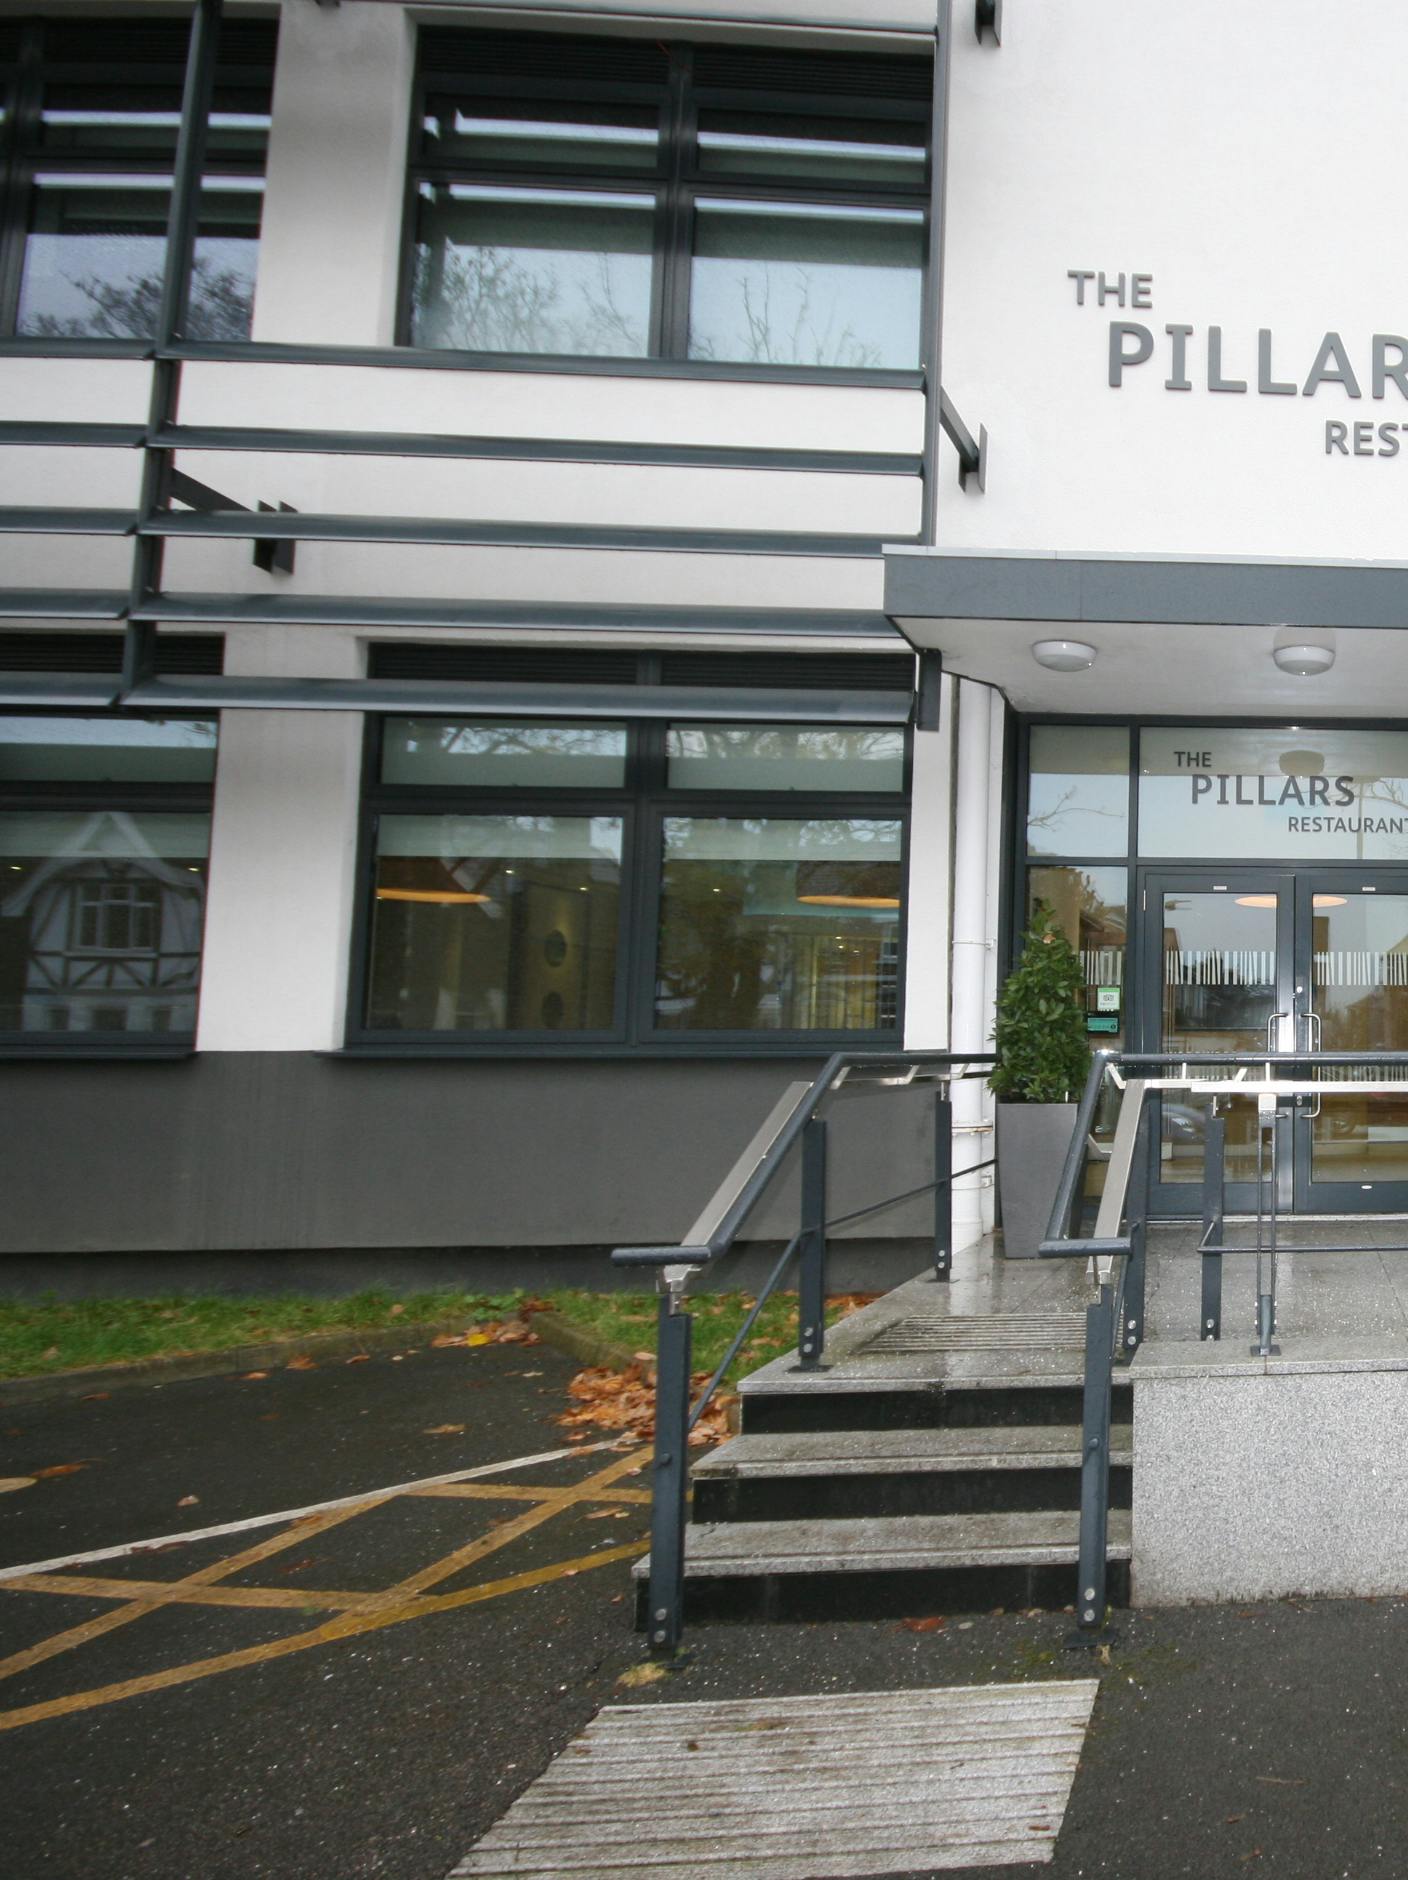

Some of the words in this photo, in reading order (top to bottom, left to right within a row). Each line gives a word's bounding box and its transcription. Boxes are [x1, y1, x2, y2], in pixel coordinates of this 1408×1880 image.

[1067, 270, 1153, 309] THE
[1174, 751, 1212, 768] THE
[1191, 774, 1355, 807] PILLARS
